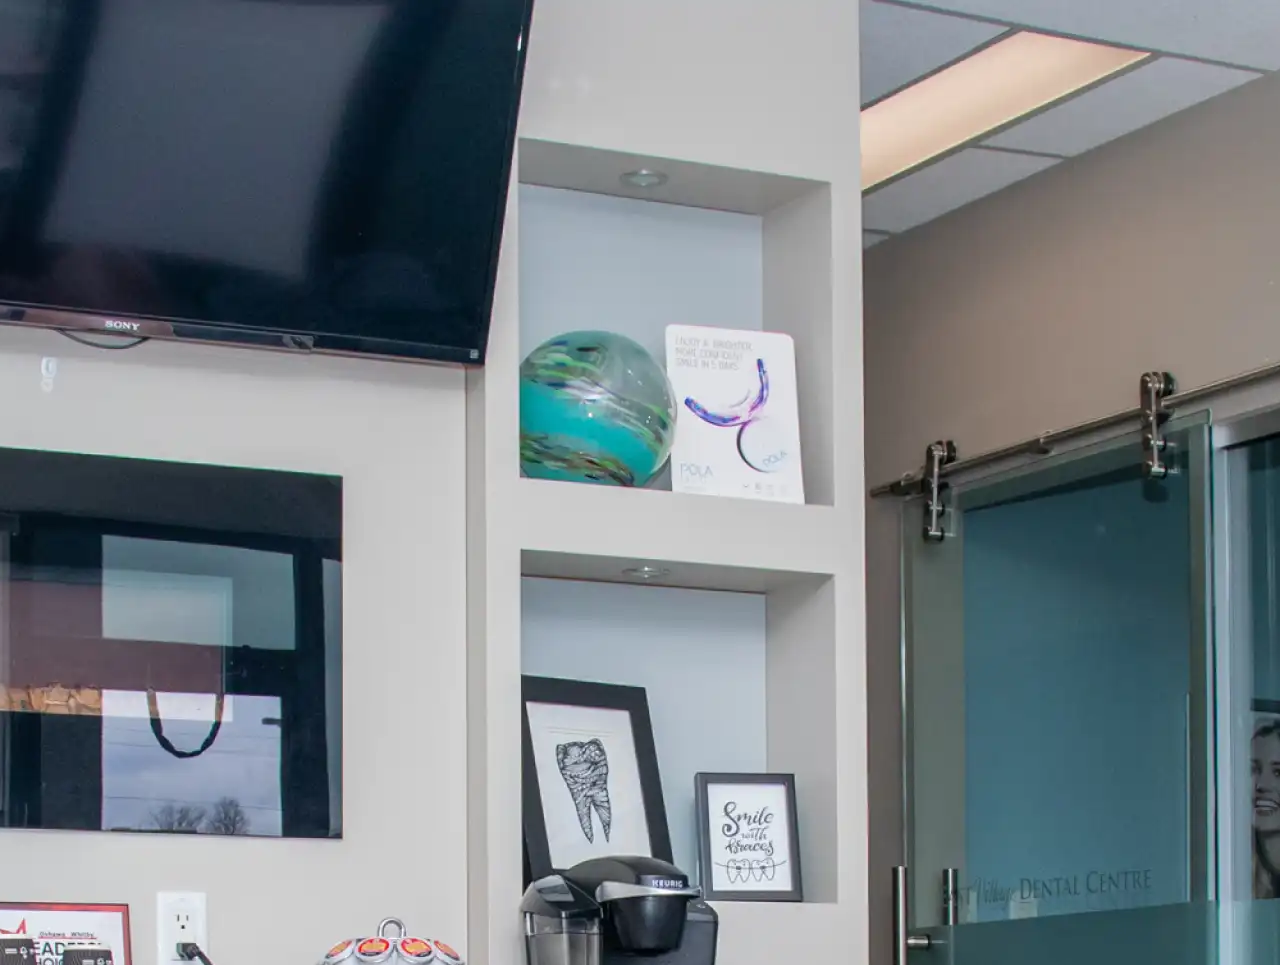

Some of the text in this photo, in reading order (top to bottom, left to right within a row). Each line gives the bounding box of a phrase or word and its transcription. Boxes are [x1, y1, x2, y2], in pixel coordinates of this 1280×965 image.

[105, 320, 140, 331] SONY
[721, 801, 774, 838] Smile
[741, 825, 770, 840] with
[652, 879, 683, 889] KEURIG
[1019, 875, 1081, 901] DENTAL
[1085, 868, 1153, 894] CENTRE
